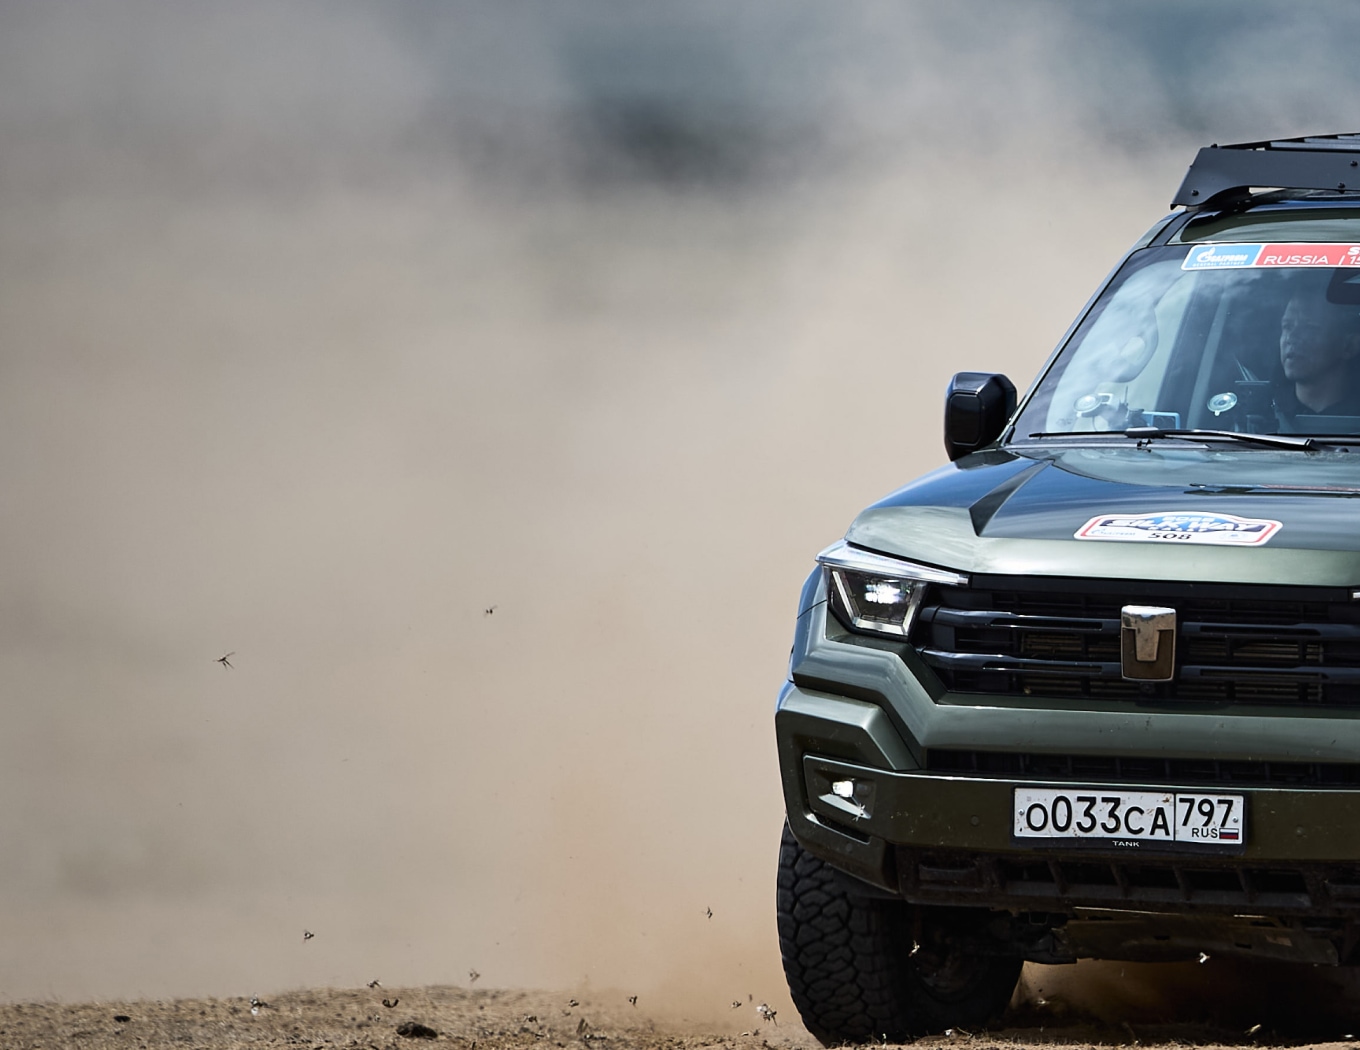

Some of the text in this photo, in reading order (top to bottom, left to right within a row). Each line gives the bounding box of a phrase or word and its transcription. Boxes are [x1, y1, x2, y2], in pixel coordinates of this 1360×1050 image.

[1263, 255, 1329, 265] RUSSIA
[1186, 520, 1262, 531] WAY
[1147, 532, 1193, 540] 508
[1179, 797, 1234, 828] 797
[1191, 827, 1219, 838] RUS
